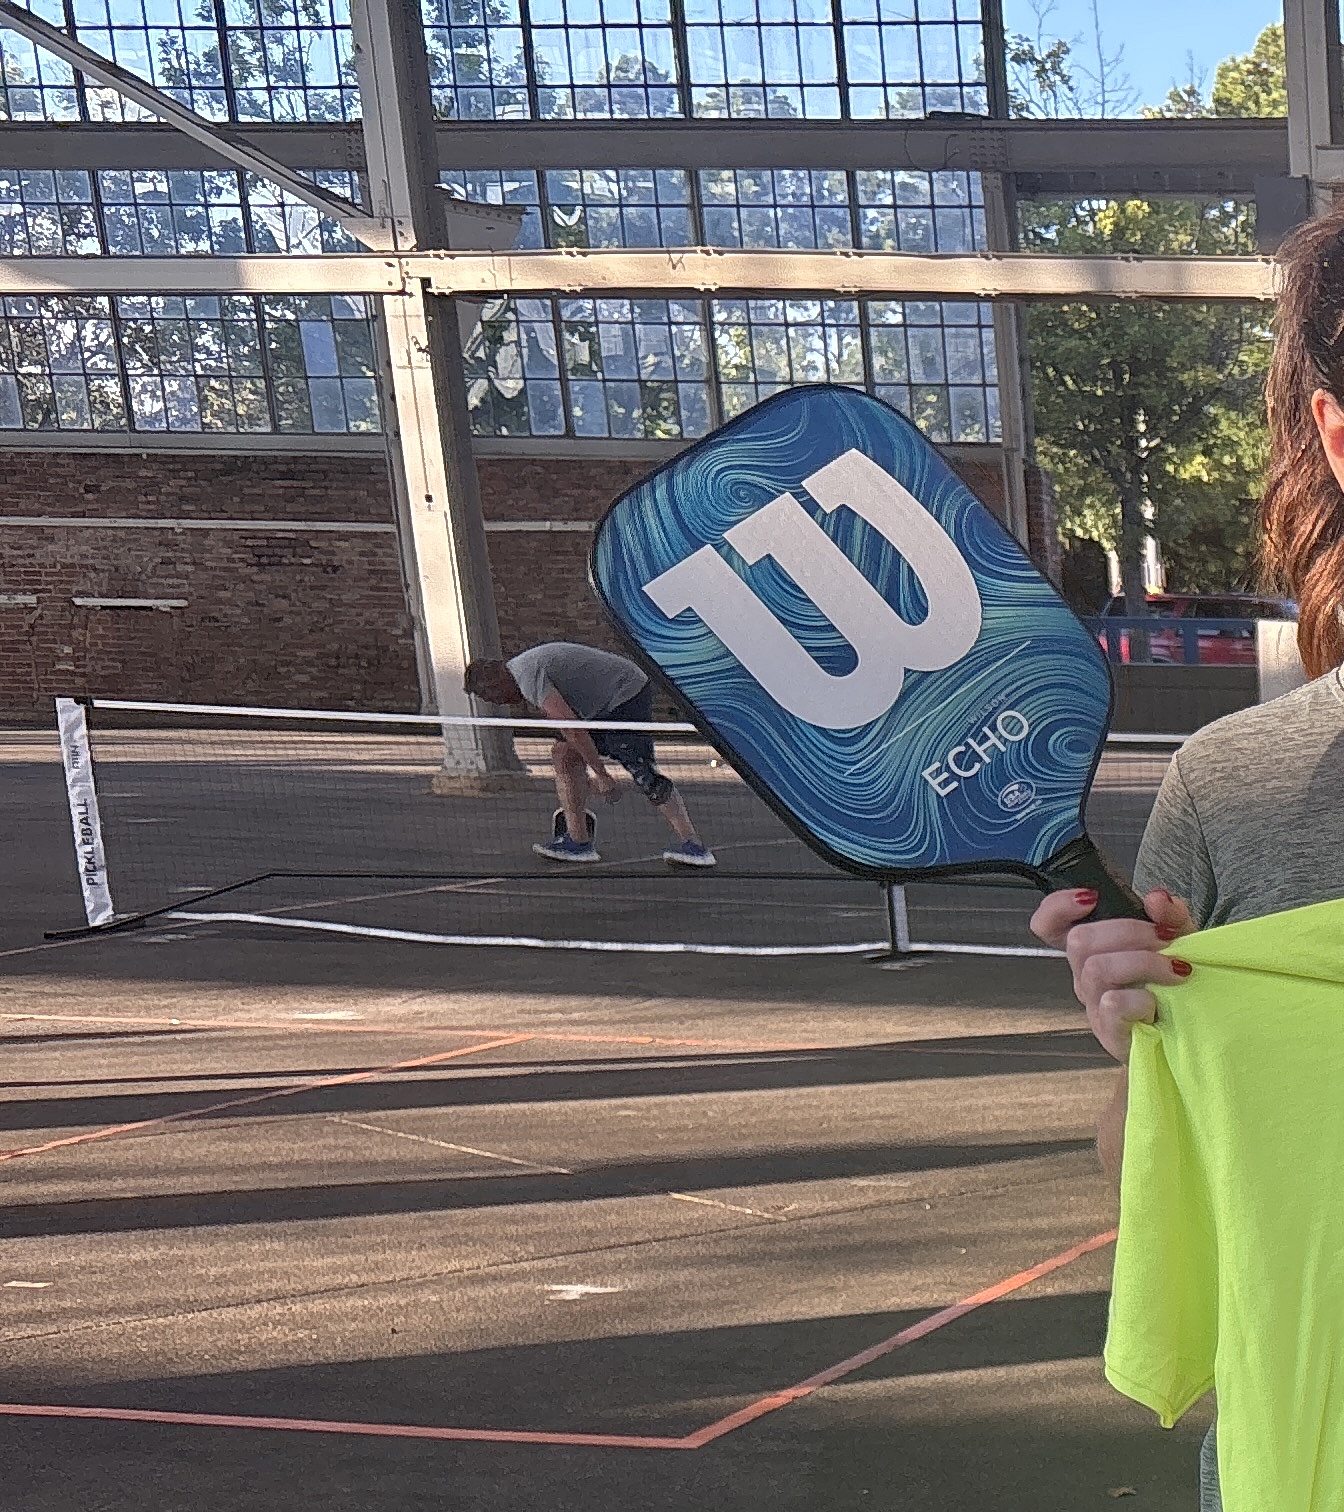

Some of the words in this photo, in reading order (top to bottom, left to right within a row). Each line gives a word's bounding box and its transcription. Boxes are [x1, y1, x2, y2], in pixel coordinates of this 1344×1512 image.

[642, 448, 982, 730] W
[921, 710, 1029, 797] ECHO
[76, 799, 99, 886] PICKLEBALL
